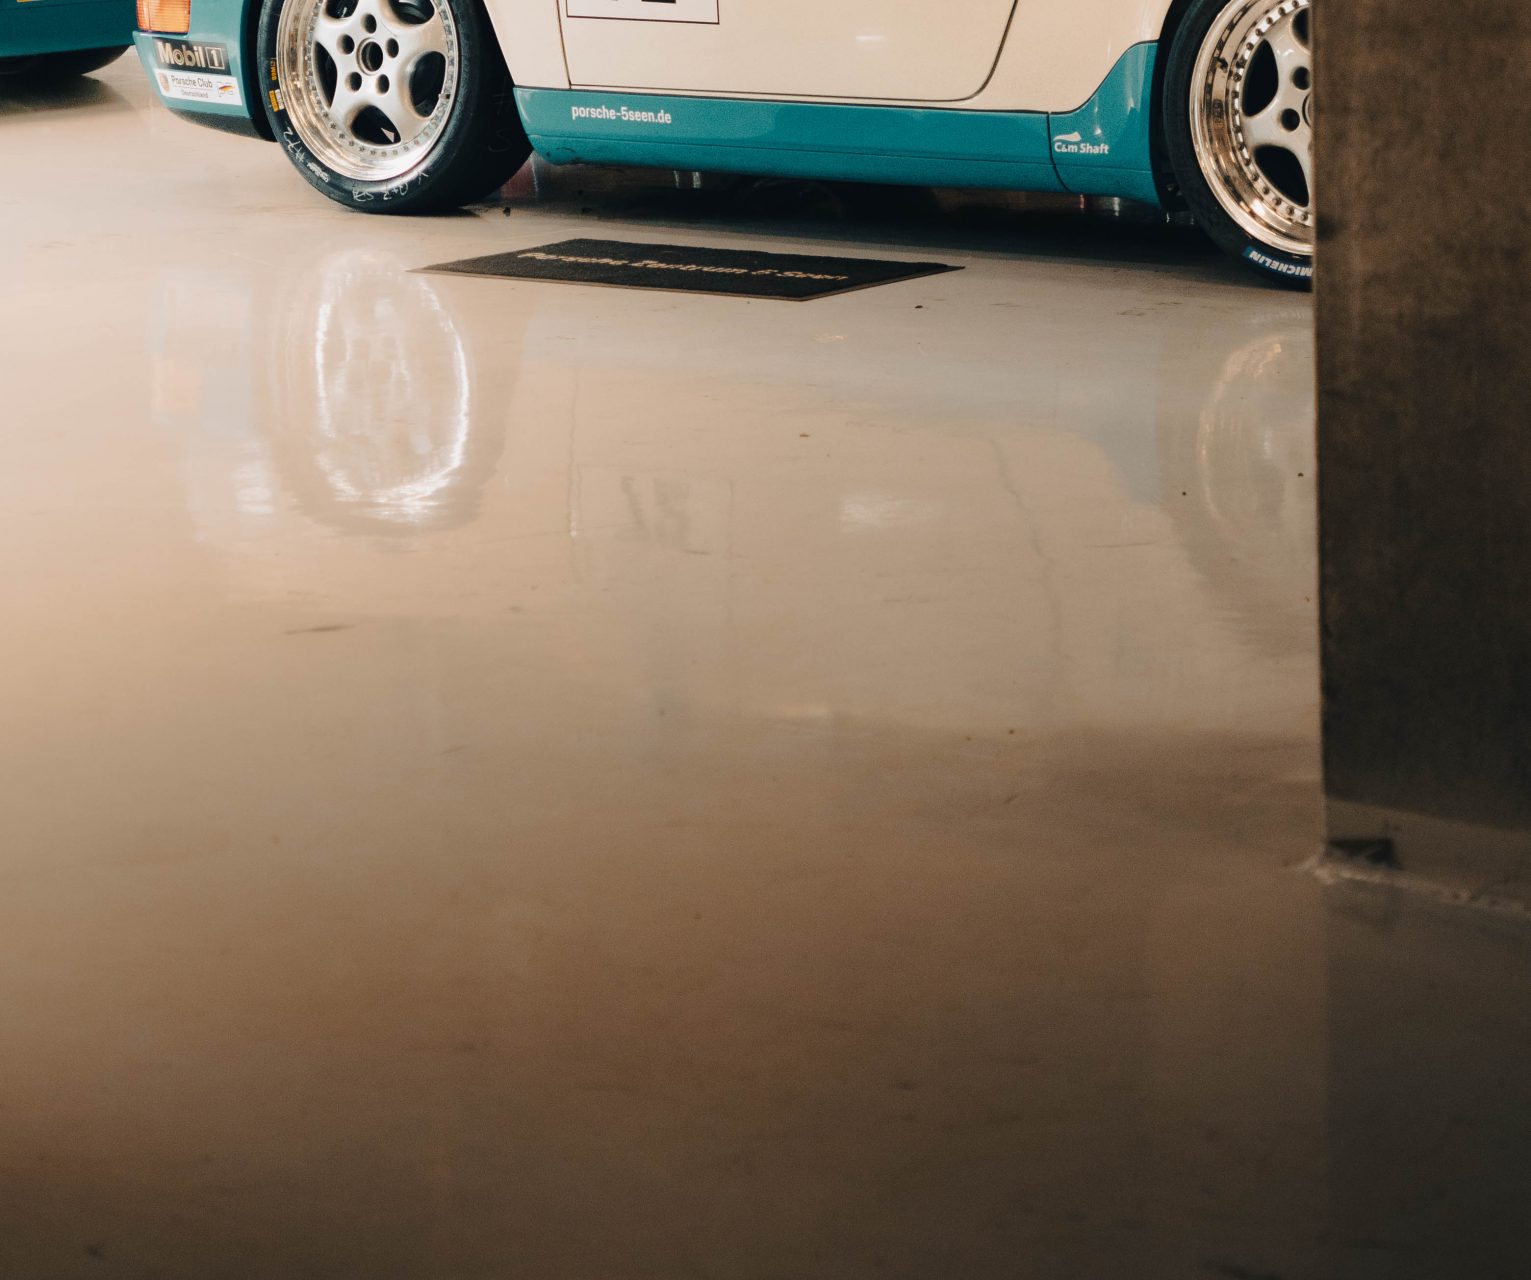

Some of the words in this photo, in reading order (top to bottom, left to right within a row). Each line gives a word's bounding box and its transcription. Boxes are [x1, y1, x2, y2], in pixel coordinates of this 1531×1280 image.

[156, 40, 206, 68] Mobil
[197, 77, 213, 88] Club
[571, 104, 672, 124] porsche-5seen.de
[1079, 142, 1109, 154] Shaft
